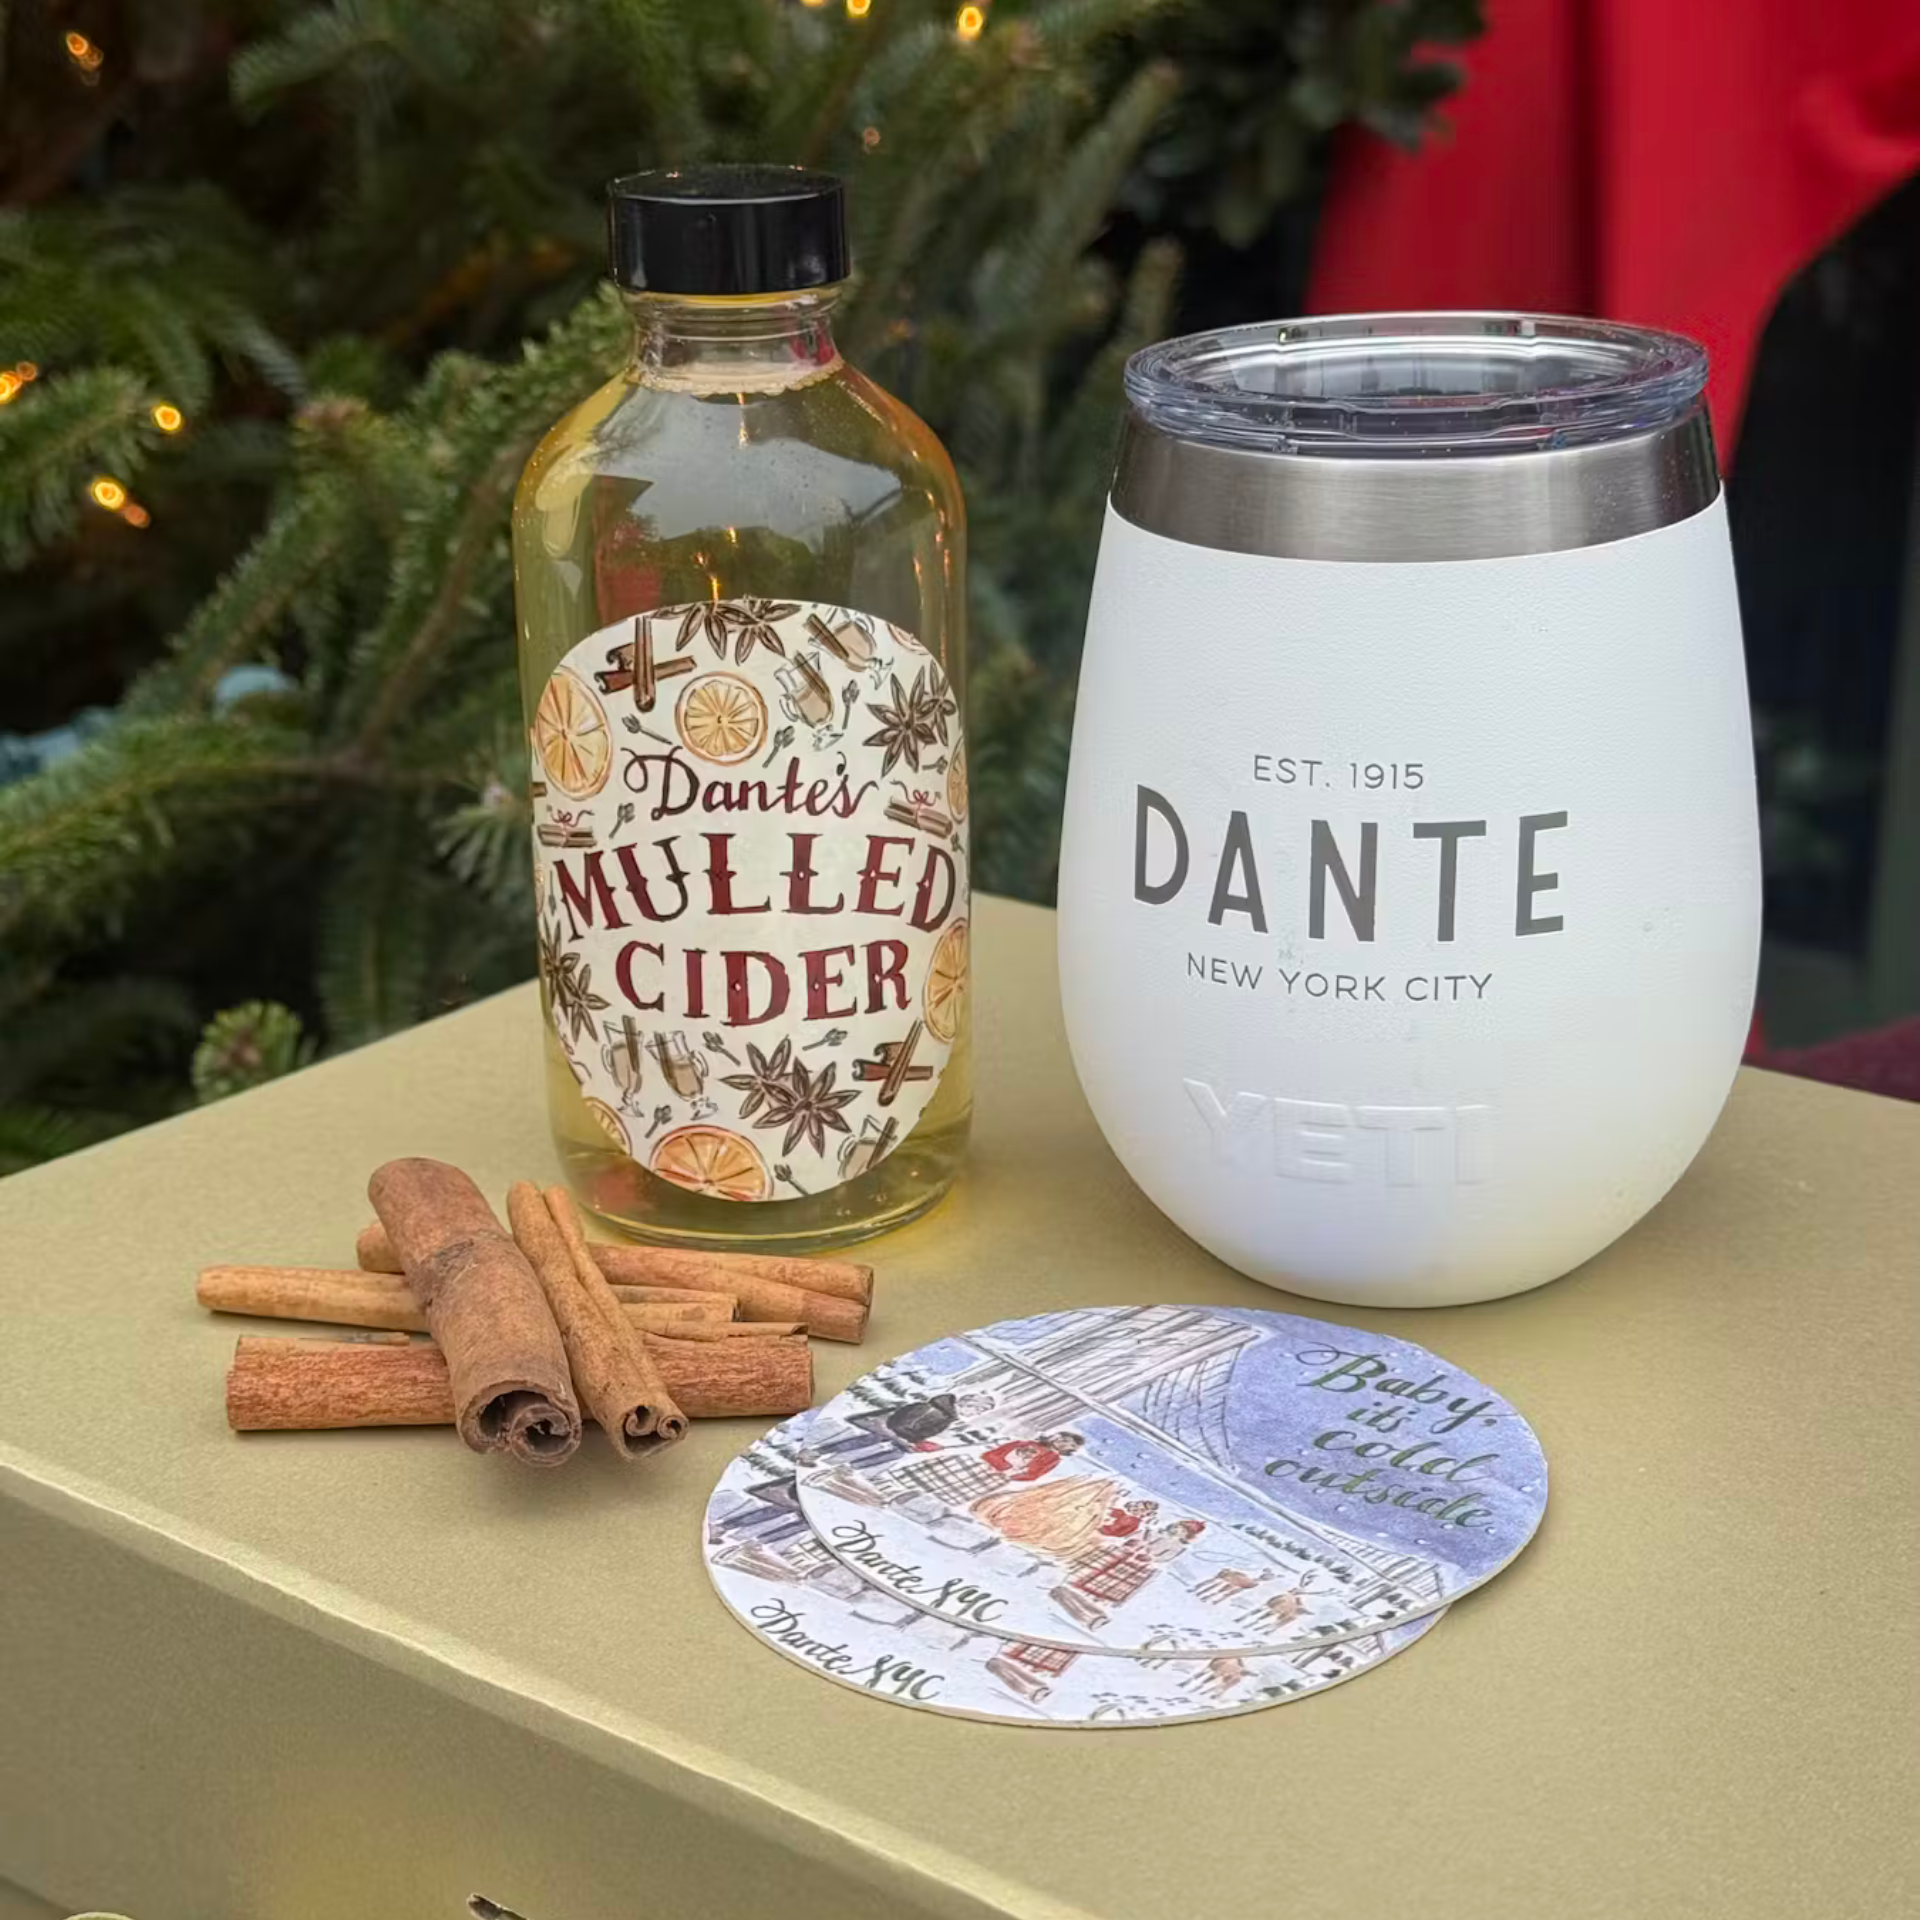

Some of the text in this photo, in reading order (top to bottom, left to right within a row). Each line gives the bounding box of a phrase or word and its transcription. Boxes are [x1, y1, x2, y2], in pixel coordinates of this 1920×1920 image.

[620, 746, 879, 821] Dante's
[1253, 755, 1424, 790] EST. 1915
[553, 832, 956, 942] MULLED
[1134, 784, 1568, 942] DANTE
[614, 939, 912, 1027] CIDER
[1187, 952, 1493, 1001] NEW YORK CITY
[1182, 1077, 1494, 1188] YETI
[1264, 1459, 1493, 1527] outside
[832, 1520, 1009, 1622] Dante NYC
[751, 1598, 945, 1701] Dante NYC
